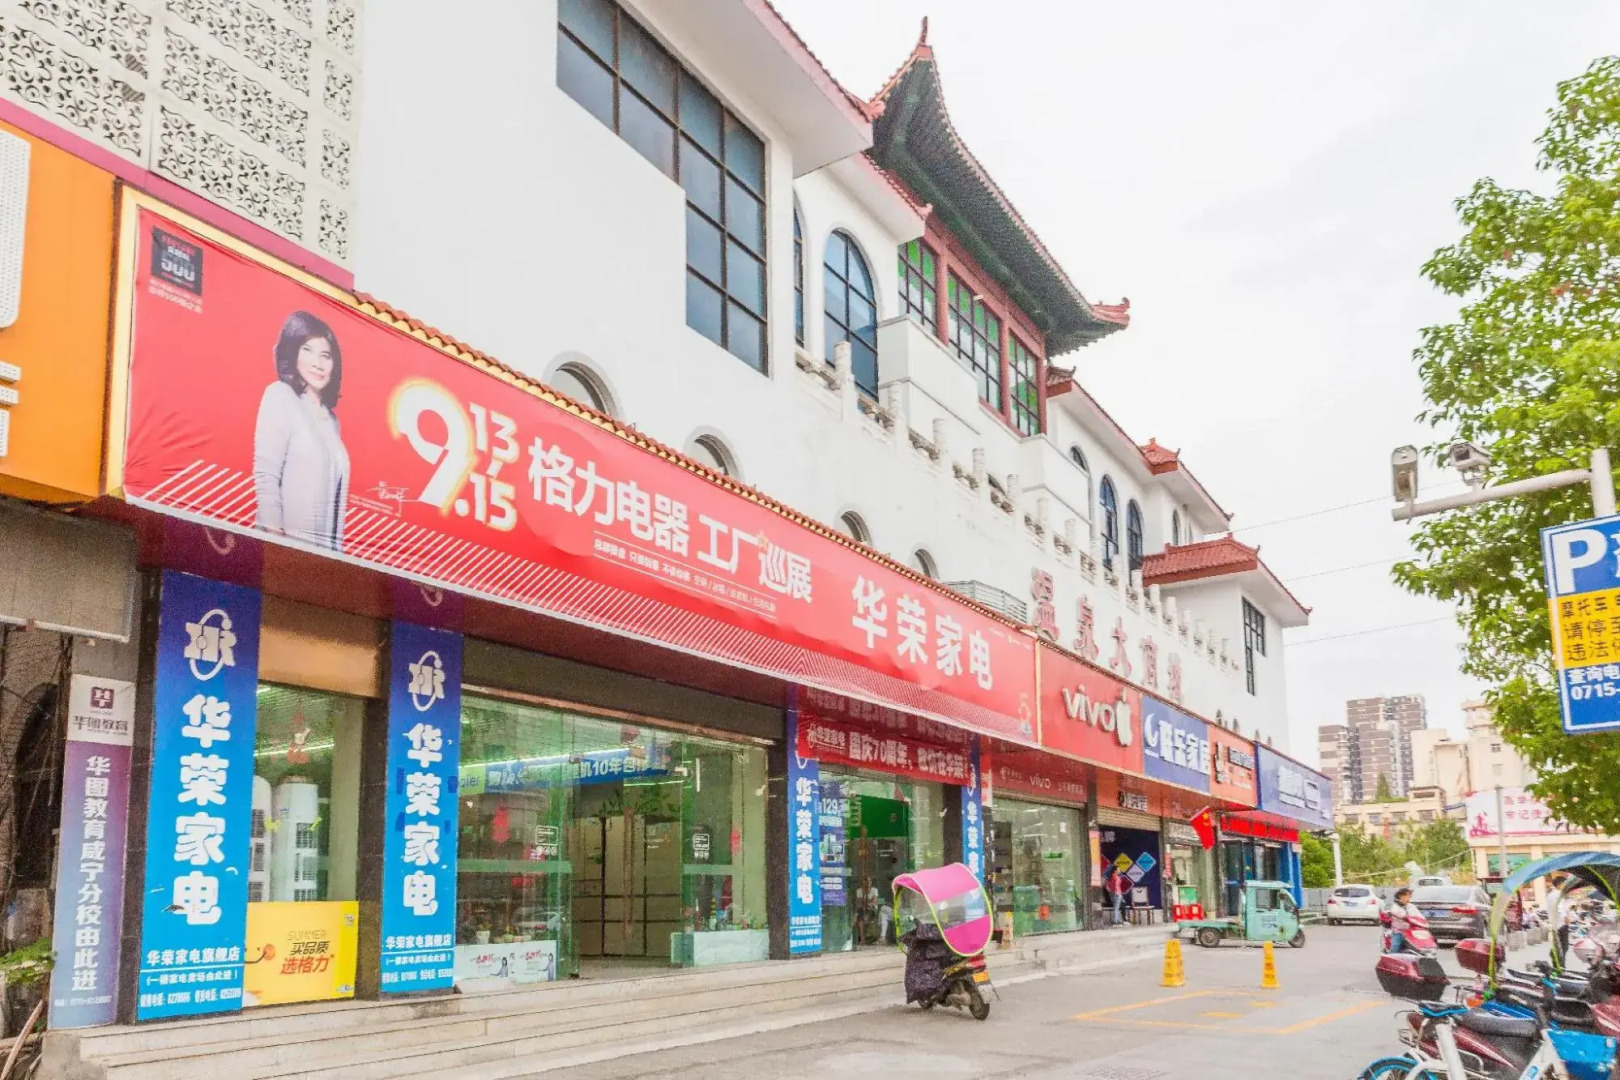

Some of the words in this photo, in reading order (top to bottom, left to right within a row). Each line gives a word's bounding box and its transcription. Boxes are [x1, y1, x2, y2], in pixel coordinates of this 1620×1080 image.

[527, 436, 691, 558] 格力电器
[697, 512, 813, 605] 工厂巡展
[852, 574, 993, 691] 华荣家电
[1062, 684, 1116, 732] vivo
[71, 755, 111, 992] 华图教育咸宁分校由此进
[173, 694, 231, 925] 华荣家电
[403, 723, 443, 916] 华荣家电
[796, 776, 814, 904] 华荣家电
[280, 955, 330, 975] 选格力
[290, 941, 330, 956] 买品质
